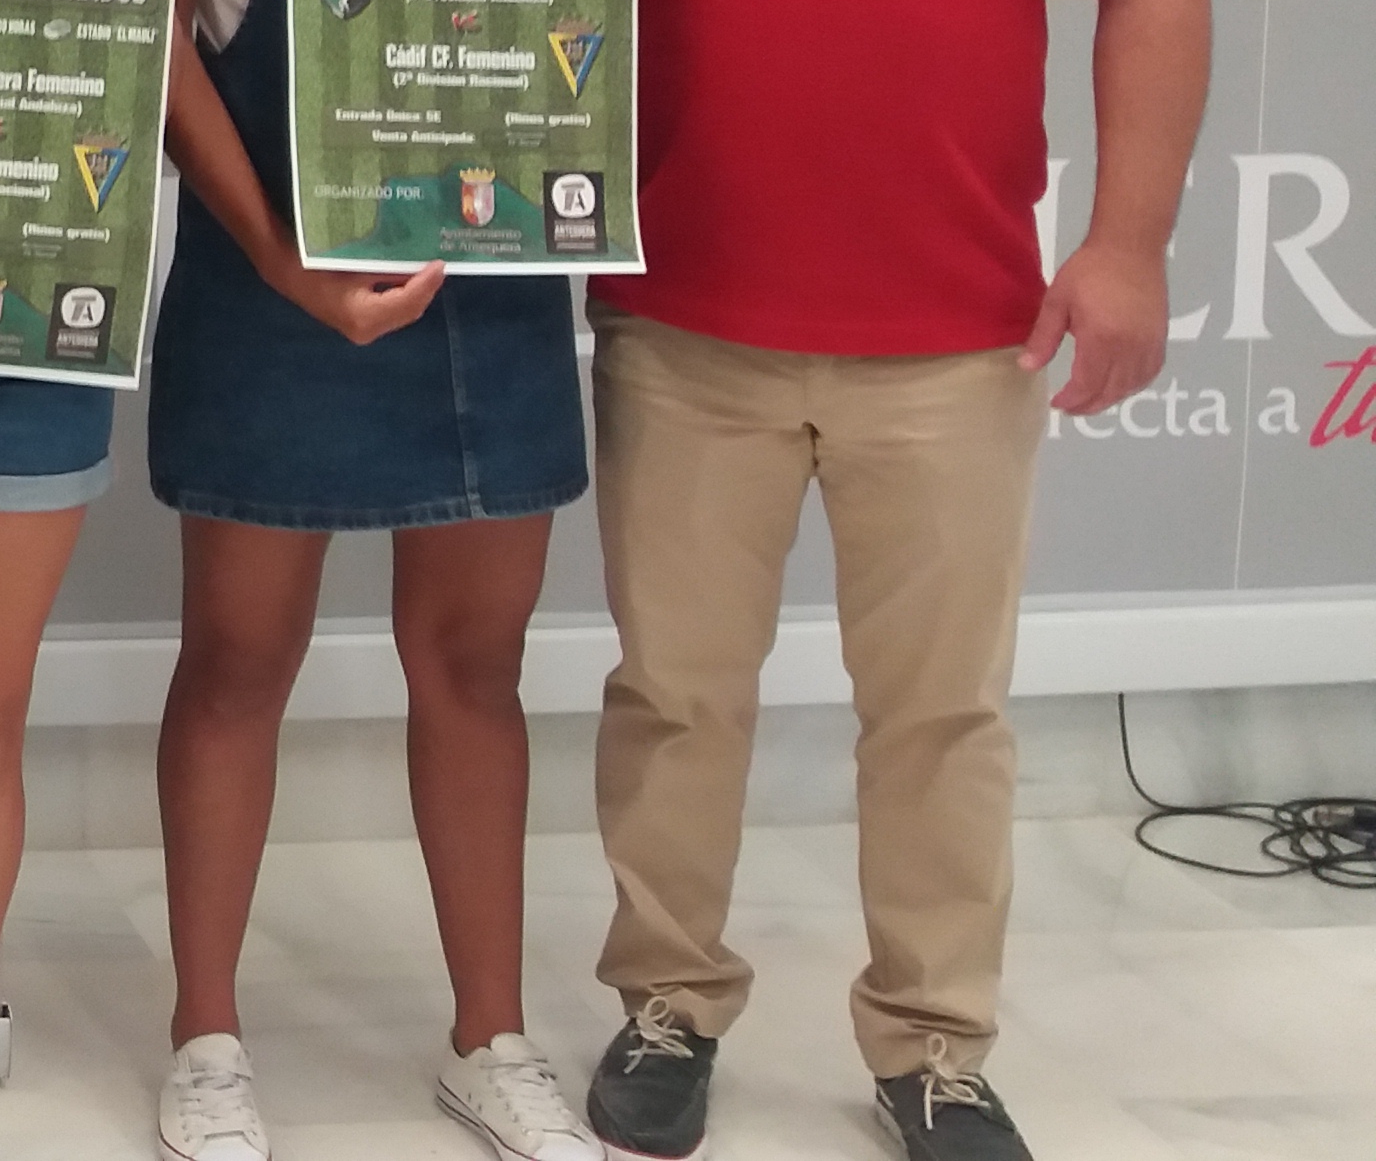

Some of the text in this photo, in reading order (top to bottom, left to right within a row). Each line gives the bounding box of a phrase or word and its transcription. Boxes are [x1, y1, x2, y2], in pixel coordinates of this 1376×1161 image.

[431, 44, 454, 69] CF.
[458, 45, 536, 71] Femenino
[26, 68, 105, 97] Femenino
[1257, 387, 1301, 434] a
